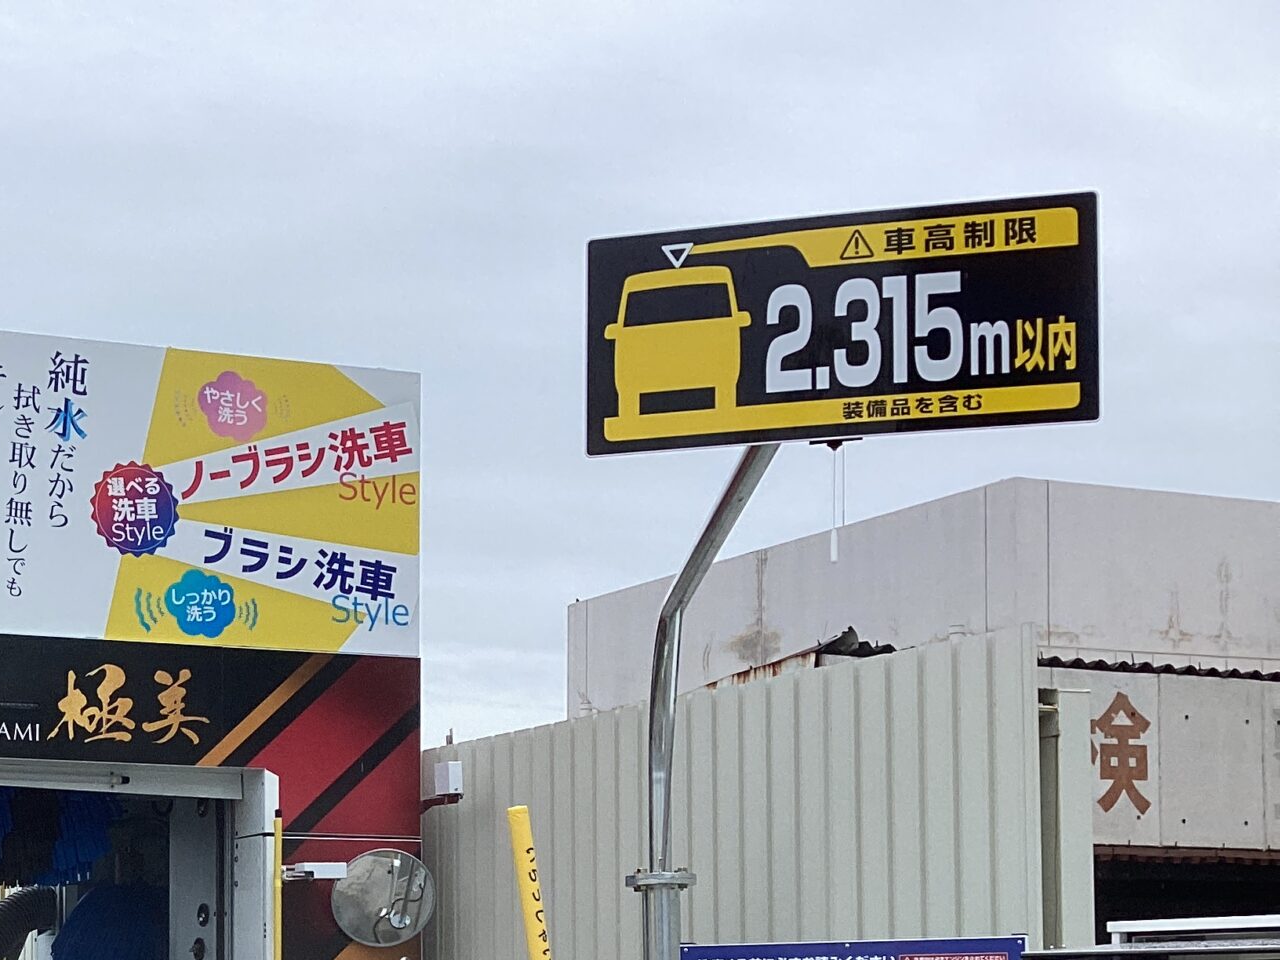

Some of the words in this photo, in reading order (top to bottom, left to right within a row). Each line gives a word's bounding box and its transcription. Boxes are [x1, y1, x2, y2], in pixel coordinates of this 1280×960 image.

[884, 215, 1037, 255] 車高制限
[203, 386, 263, 412] やさしく
[842, 393, 982, 420] 装備品を含む
[217, 405, 248, 427] 洗う
[45, 350, 89, 529] 純水だから
[180, 421, 413, 500] ノーブラシ洗車
[4, 383, 42, 597] 拭き取り無しでも
[106, 476, 160, 497] 選べる
[338, 472, 417, 509] Style
[111, 496, 158, 522] 洗車
[111, 521, 165, 546] Style
[203, 528, 397, 601] ブラシ洗車
[171, 588, 232, 608] しっかり
[186, 604, 217, 622] 洗う
[331, 594, 409, 632] Style
[47, 663, 210, 745] 極美
